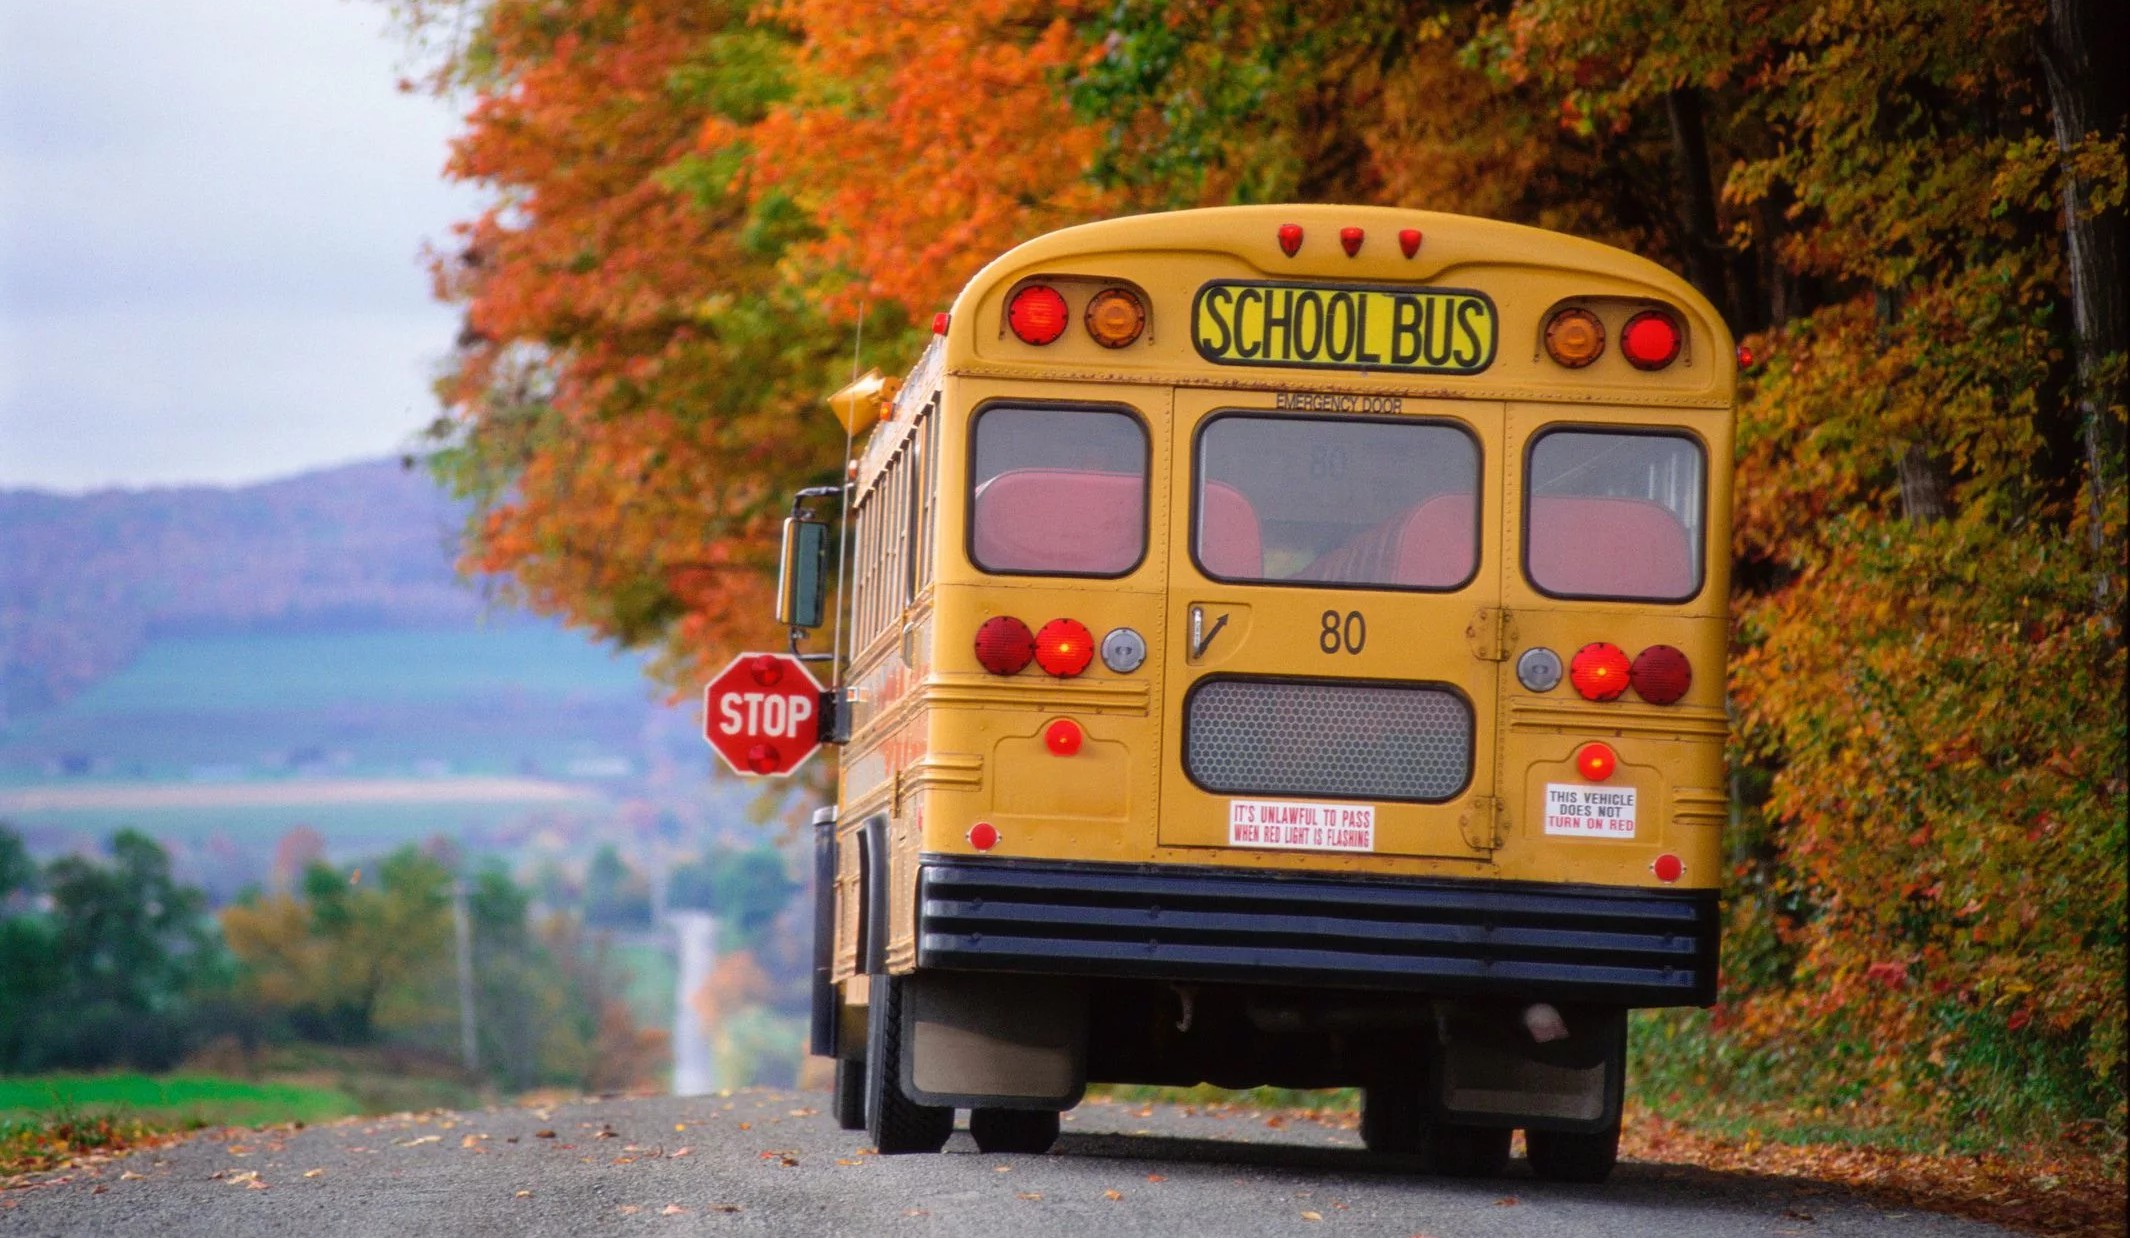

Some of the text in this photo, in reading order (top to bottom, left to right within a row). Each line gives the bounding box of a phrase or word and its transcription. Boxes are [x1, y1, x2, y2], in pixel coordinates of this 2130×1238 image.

[1202, 287, 1484, 368] SCHOOL BUS
[1277, 393, 1402, 414] EMERGENCY DOOR
[1320, 609, 1366, 655] 80
[719, 692, 812, 738] STOP
[1550, 791, 1634, 806] THIS VEHICLE
[1234, 805, 1370, 828] IT'S UNLAWFUL TO PASS
[1560, 804, 1623, 818] DOES NOT
[1549, 816, 1634, 831] TURN ON RED
[1234, 824, 1369, 848] WHEN RED LIGHT IS FLASHING
